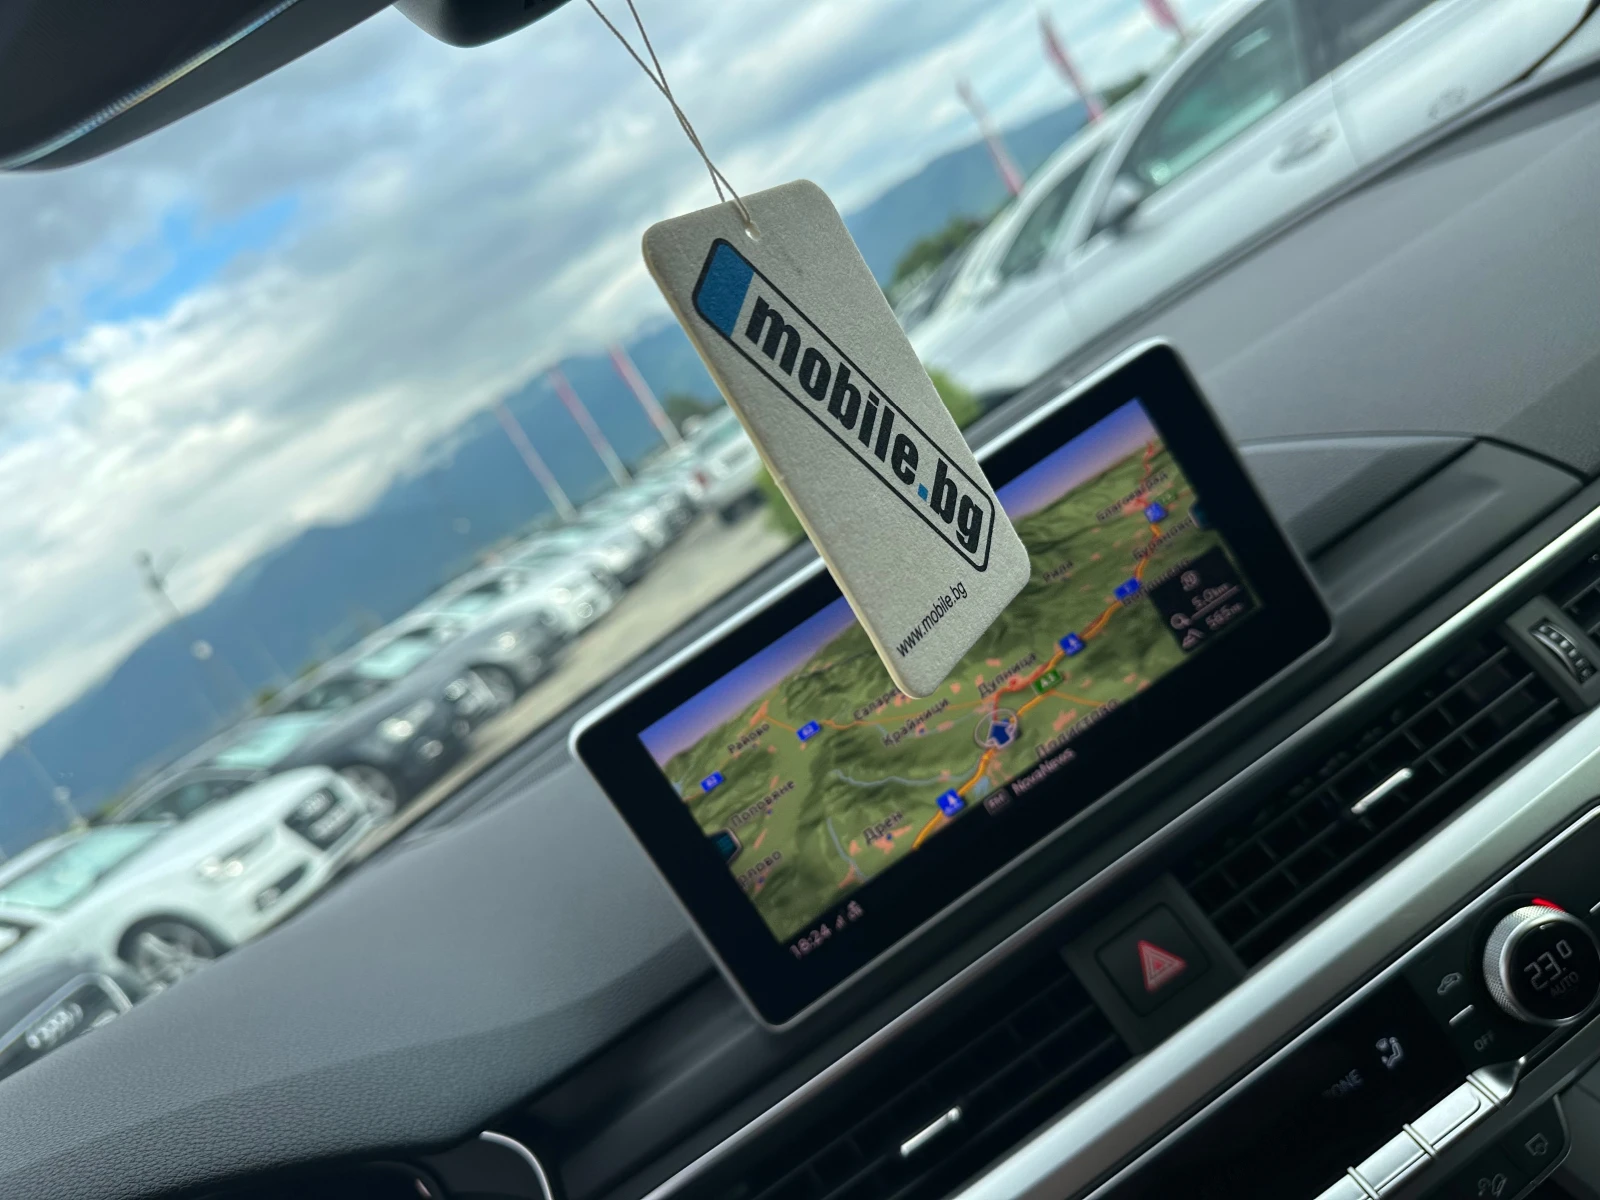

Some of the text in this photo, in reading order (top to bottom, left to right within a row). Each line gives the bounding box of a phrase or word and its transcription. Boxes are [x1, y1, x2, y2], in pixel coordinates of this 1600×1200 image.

[746, 296, 984, 554] mobile.bg
[896, 581, 968, 657] www.mobile.bg
[978, 653, 1036, 699] Дупница
[853, 687, 901, 721] Сапаре
[882, 698, 949, 748] Крайници
[727, 723, 770, 754] Райово
[731, 780, 796, 828] Поповяне
[863, 811, 904, 847] Дрен
[1523, 939, 1573, 991] 23.0
[1473, 1029, 1496, 1052] OFF
